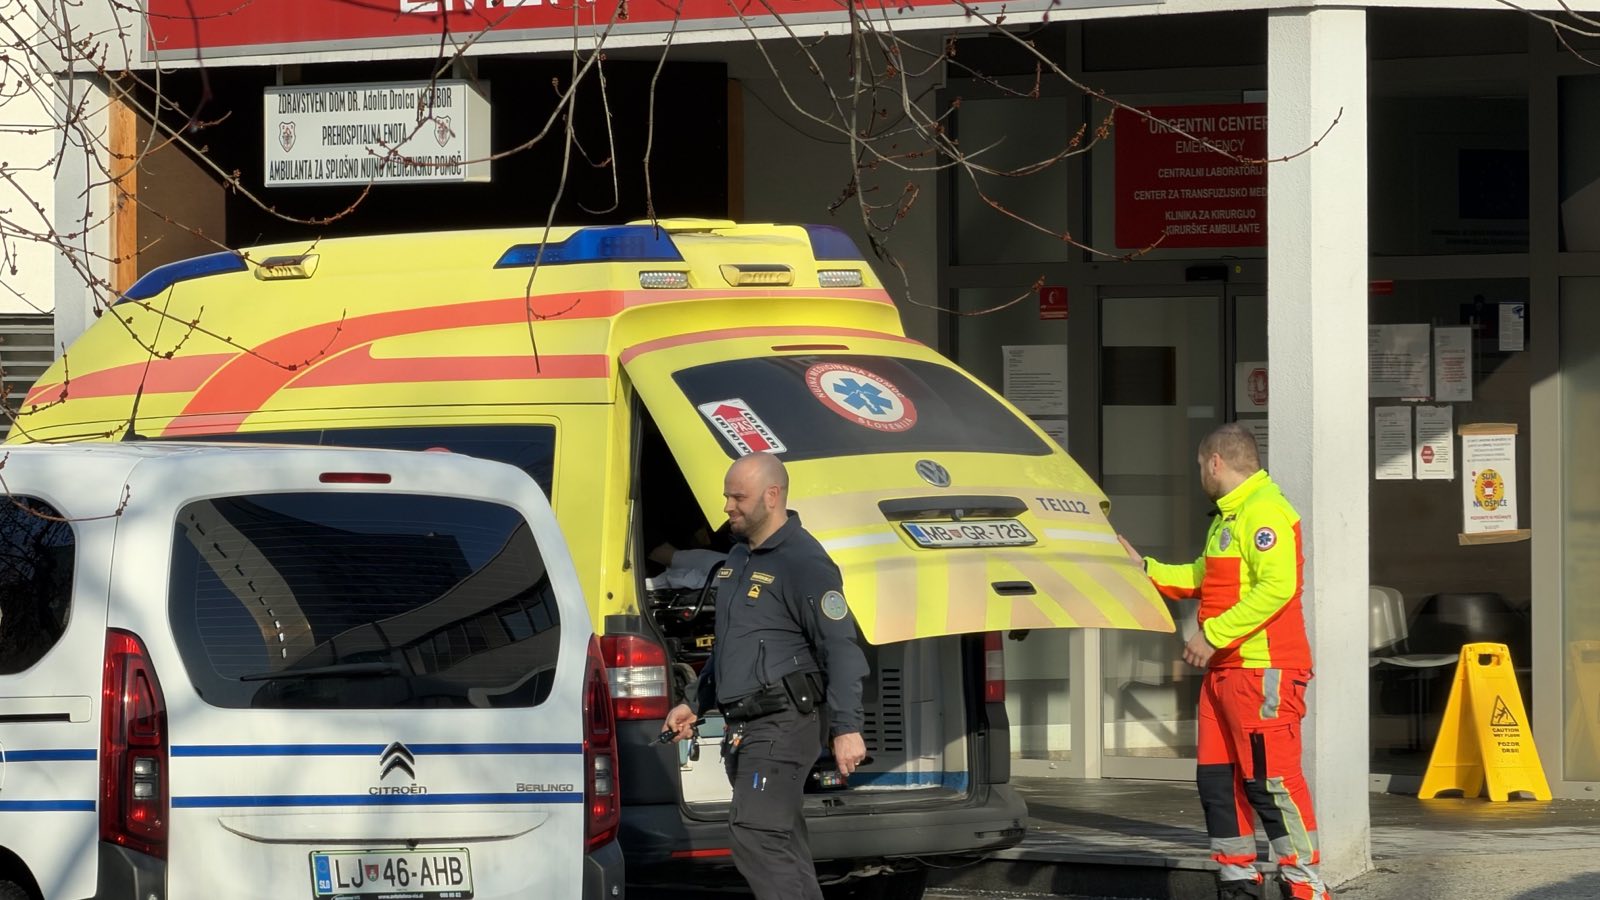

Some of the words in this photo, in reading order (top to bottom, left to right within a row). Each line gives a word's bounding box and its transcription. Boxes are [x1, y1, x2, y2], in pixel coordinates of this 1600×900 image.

[278, 90, 327, 114] ZDRAVSTVENI
[329, 89, 346, 113] DOM
[348, 90, 361, 112] DR.
[363, 88, 388, 110] Adolfa
[390, 88, 415, 110] Drolca
[322, 124, 382, 146] PREHOSPITALNA
[384, 122, 407, 144] ENOTA
[1150, 118, 1215, 135] URGENTNI
[1176, 139, 1245, 153] EMERGENCY
[269, 159, 313, 181] AMBULANTA
[315, 159, 324, 180] ZA
[326, 155, 358, 179] SPLOŠNO
[386, 156, 432, 178] MEDICINSKO
[1158, 168, 1204, 178] CENTRALNI
[1205, 166, 1263, 177] LABORATORIJ
[1134, 190, 1167, 201] CENTER
[1168, 189, 1179, 200] ZA
[1181, 187, 1248, 199] TRANSFUZIJSKO
[1165, 210, 1198, 220] KLINIKA
[1199, 210, 1210, 220] ZA
[1211, 208, 1256, 220] KIRURGIJO
[1166, 222, 1208, 235] KIRURŠKE
[1209, 223, 1260, 235] AMBULANTE
[923, 526, 953, 541] MB
[960, 524, 1027, 540] GR-726
[369, 783, 427, 795] CITROËN
[335, 859, 364, 889] LJ
[383, 856, 464, 887] 46-AHB
